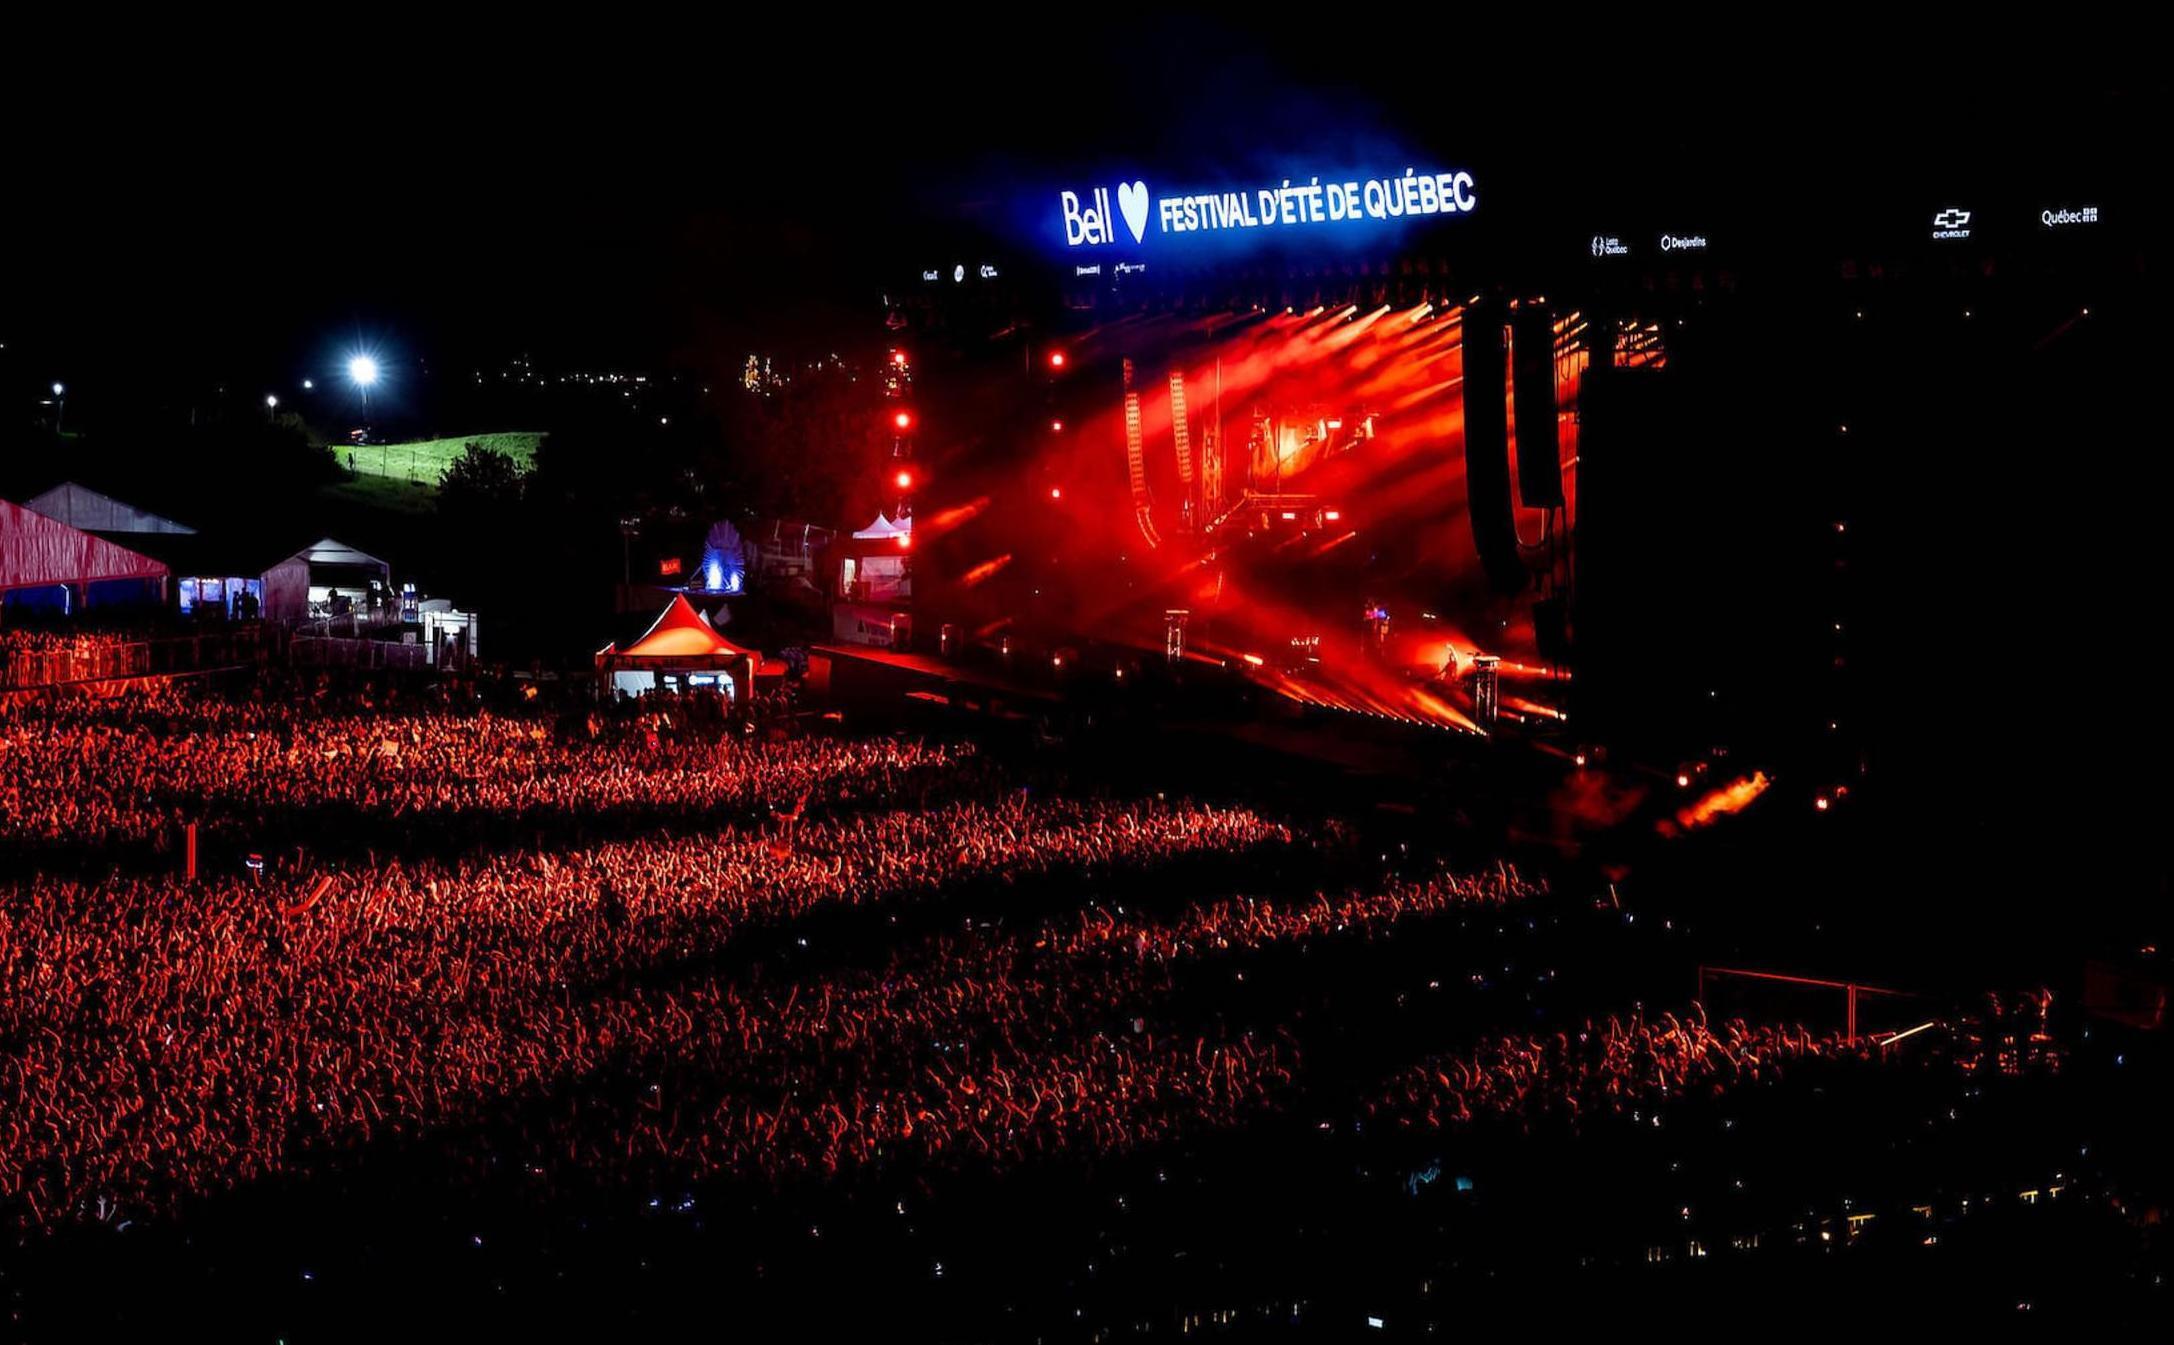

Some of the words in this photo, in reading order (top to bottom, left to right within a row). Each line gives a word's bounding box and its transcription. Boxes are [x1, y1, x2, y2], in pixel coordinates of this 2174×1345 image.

[1061, 188, 1114, 246] Bell
[1159, 192, 1259, 232] FESTIVAL
[1258, 177, 1326, 225] D'ÉTÉ
[1327, 181, 1363, 221] DE
[1364, 168, 1477, 220] QUÉBEC
[2042, 208, 2082, 227] Québec
[1672, 236, 1706, 249] Desjardins
